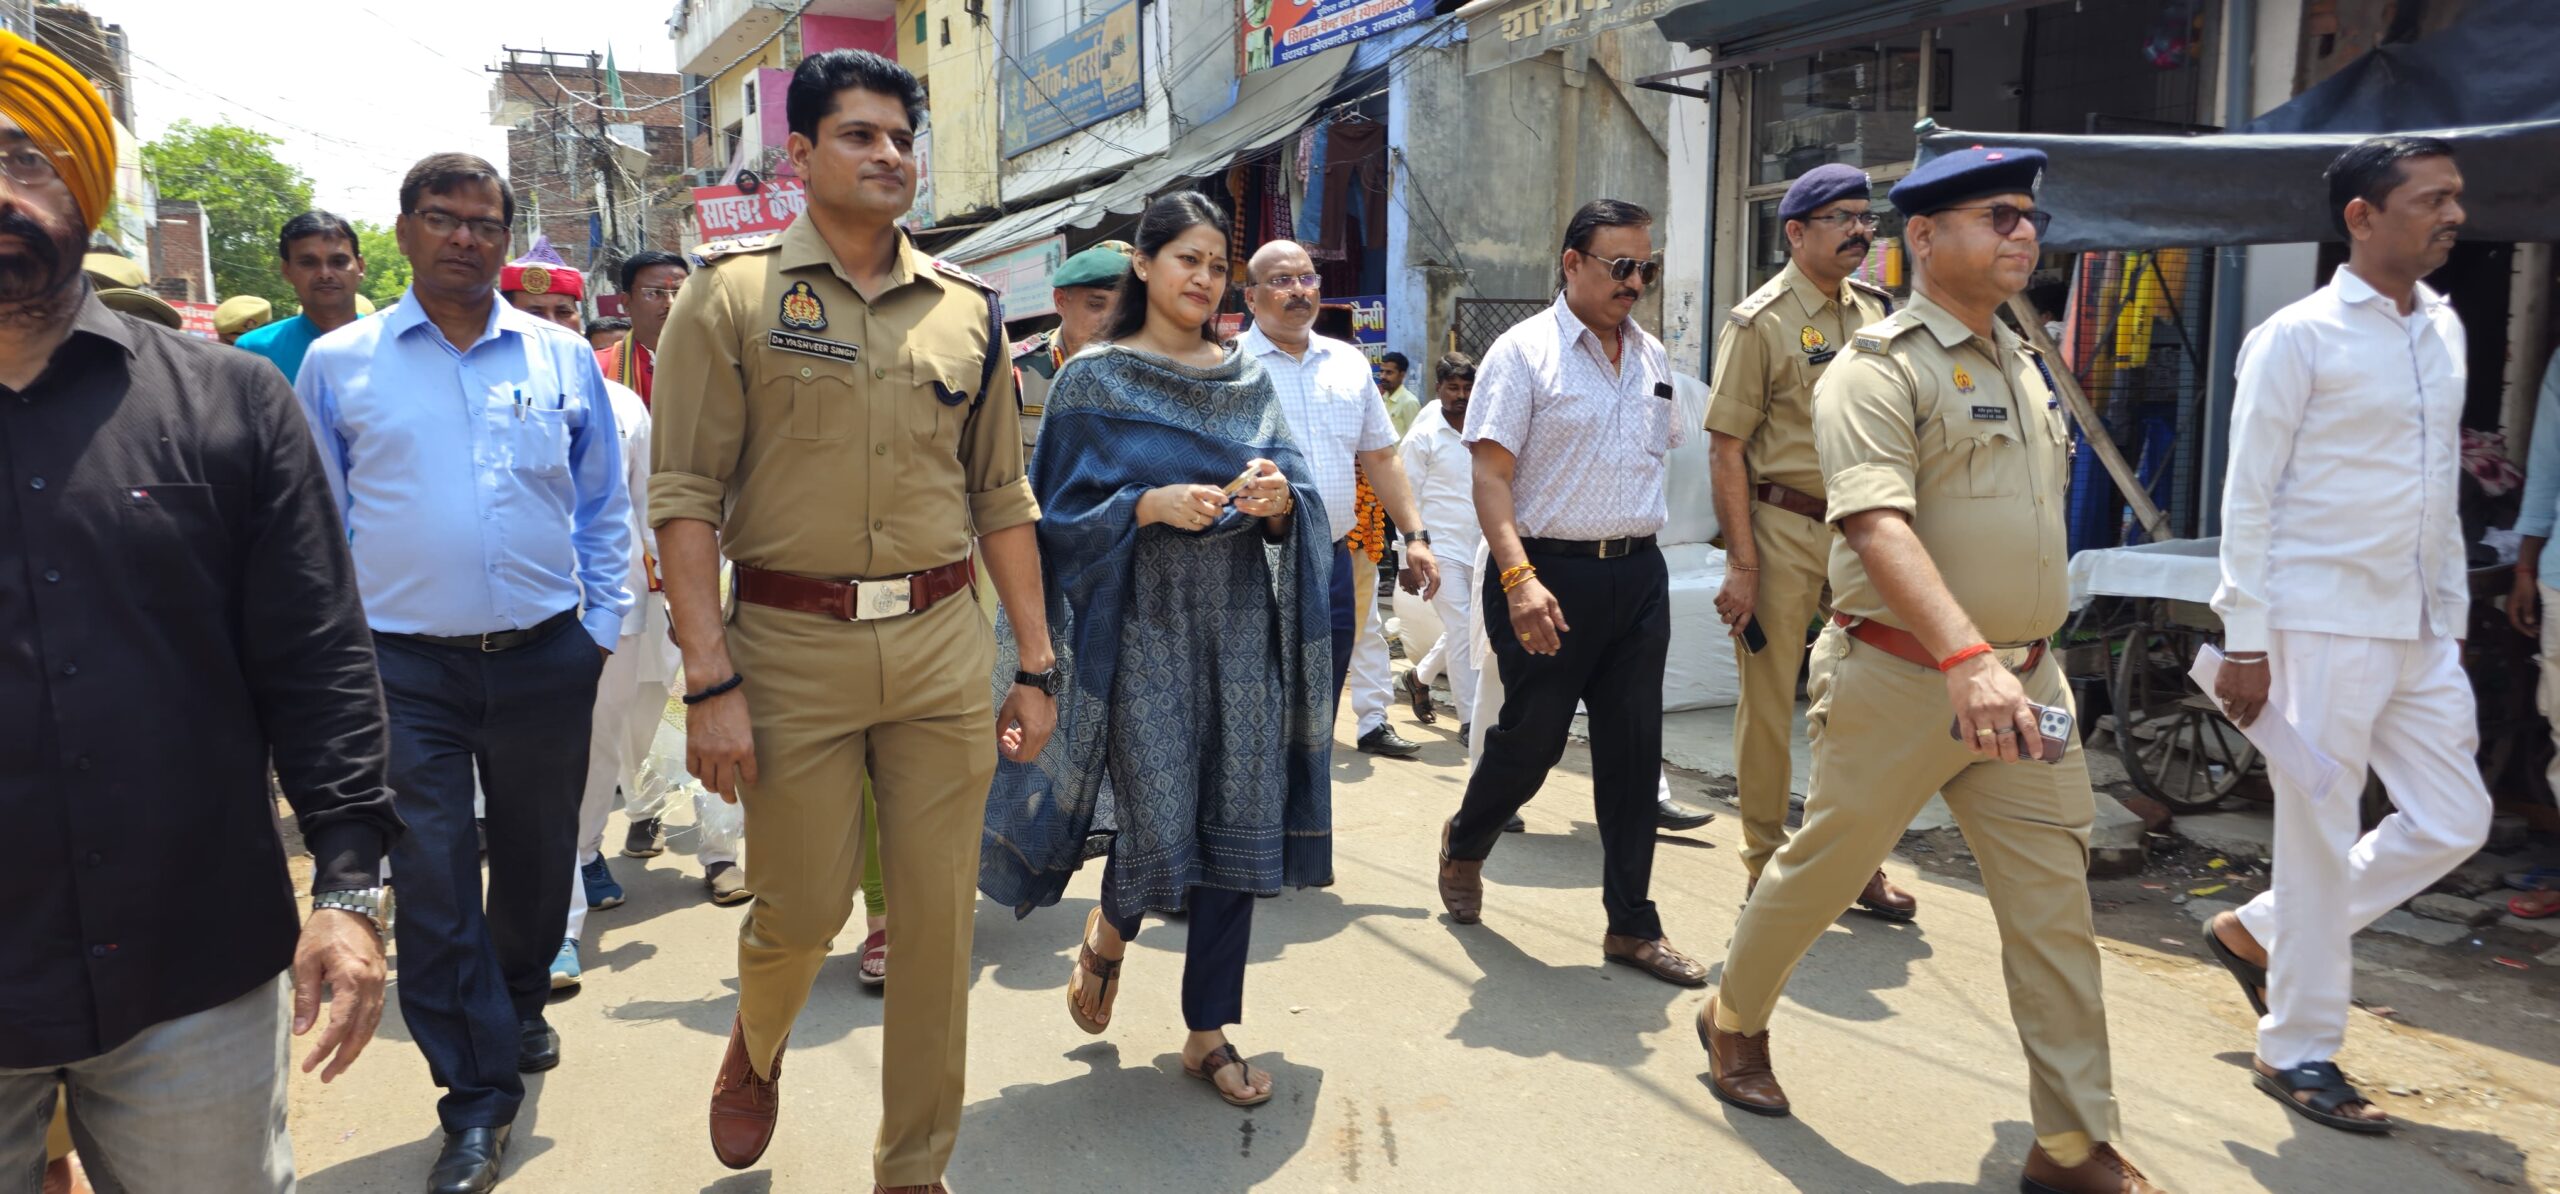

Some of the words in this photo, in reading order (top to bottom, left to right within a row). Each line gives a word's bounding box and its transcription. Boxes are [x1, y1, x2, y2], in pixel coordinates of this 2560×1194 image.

[1310, 29, 1348, 51] कोतवाली
[1371, 6, 1416, 31] रायबरेली
[698, 194, 763, 231] साइबर
[765, 181, 806, 220] कैफे
[829, 345, 856, 358] SINGH
